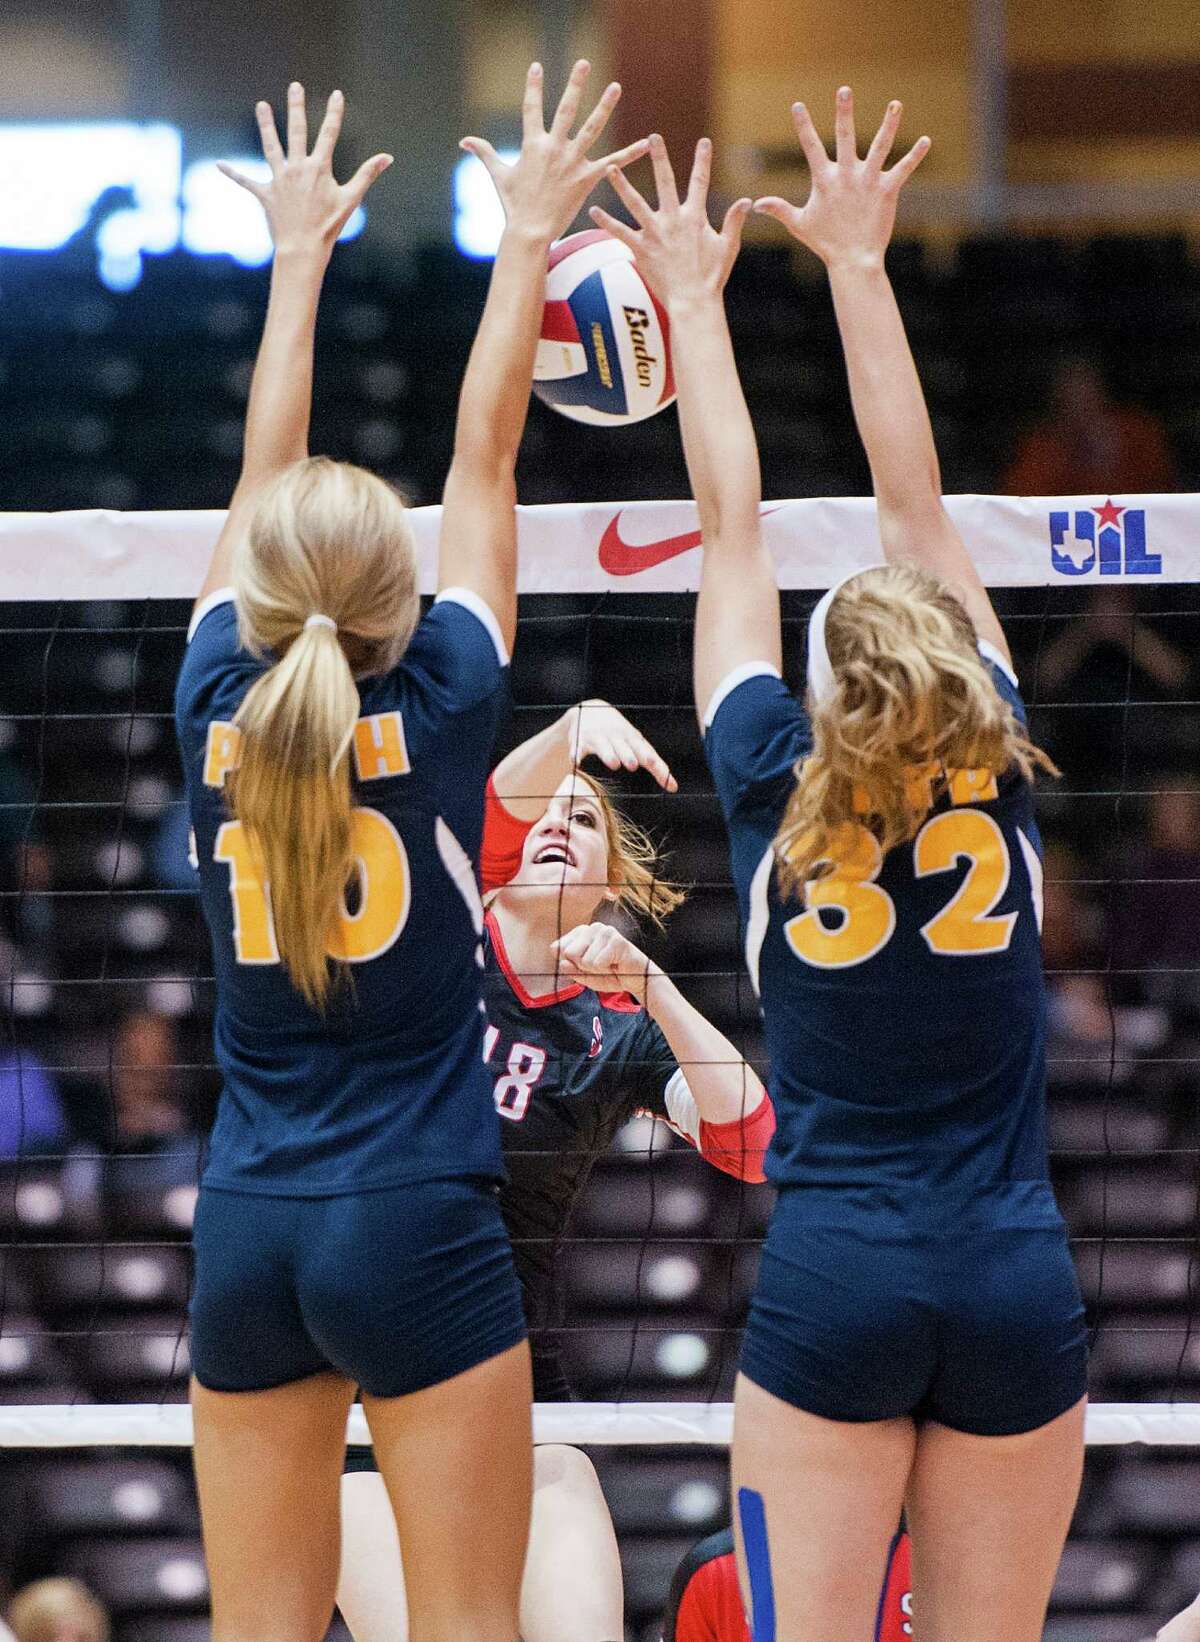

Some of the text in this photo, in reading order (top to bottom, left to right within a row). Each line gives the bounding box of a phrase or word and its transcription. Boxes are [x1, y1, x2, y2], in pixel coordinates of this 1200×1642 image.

[622, 305, 658, 388] Baden
[1049, 505, 1162, 576] UIL
[203, 711, 411, 787] PH
[213, 806, 411, 964] 10
[784, 808, 1019, 969] 32
